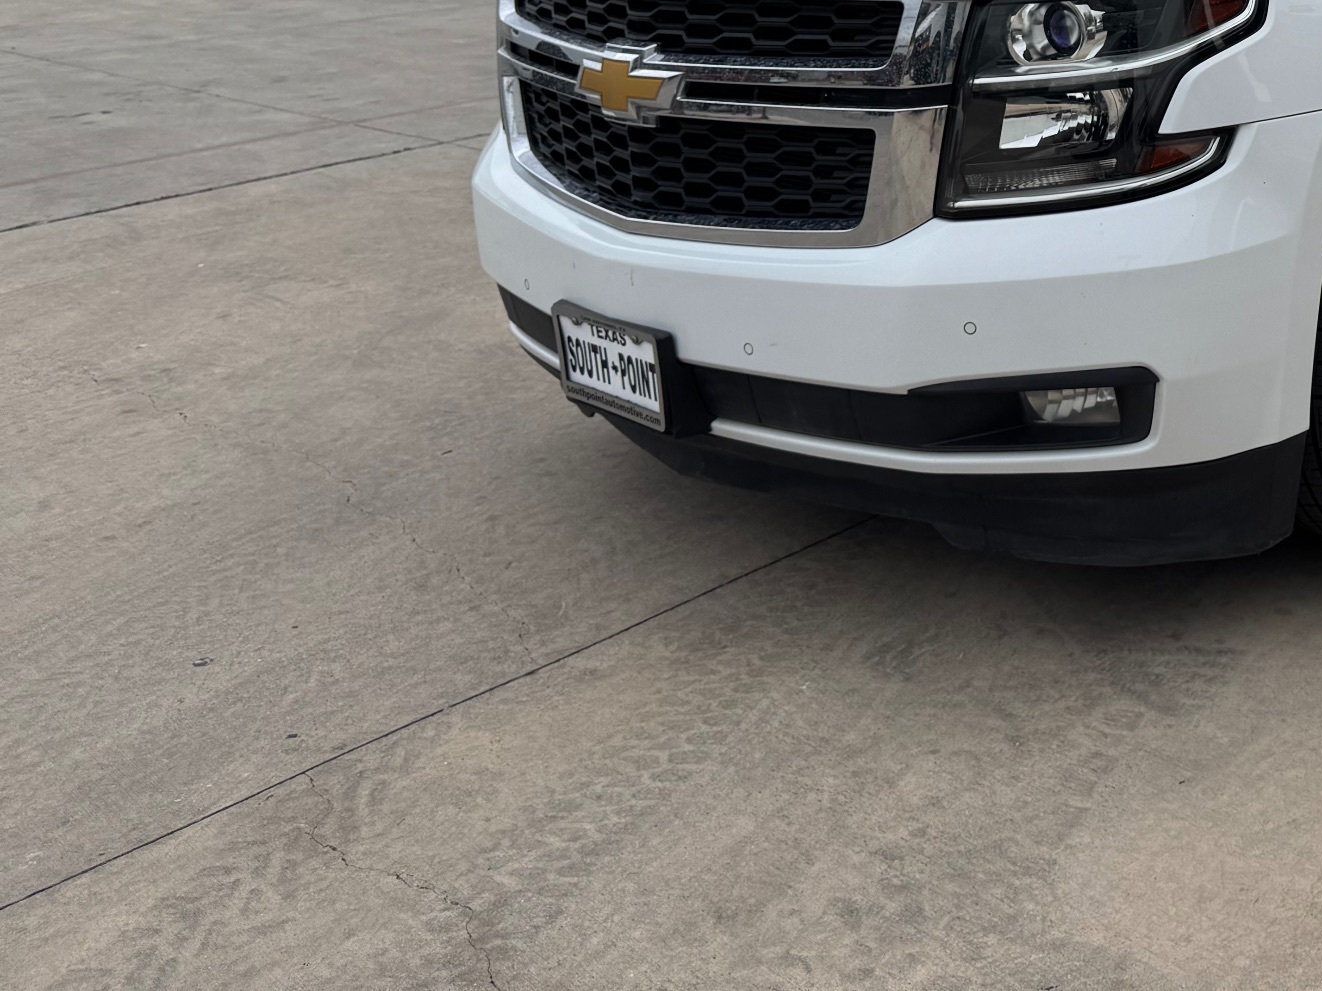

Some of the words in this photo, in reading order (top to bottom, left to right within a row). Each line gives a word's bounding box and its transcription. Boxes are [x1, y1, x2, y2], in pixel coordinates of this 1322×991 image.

[588, 323, 627, 346] TEXAS
[567, 335, 611, 385] SOUTH
[618, 352, 658, 402] POINT
[566, 385, 662, 426] southpointautomotive.com
